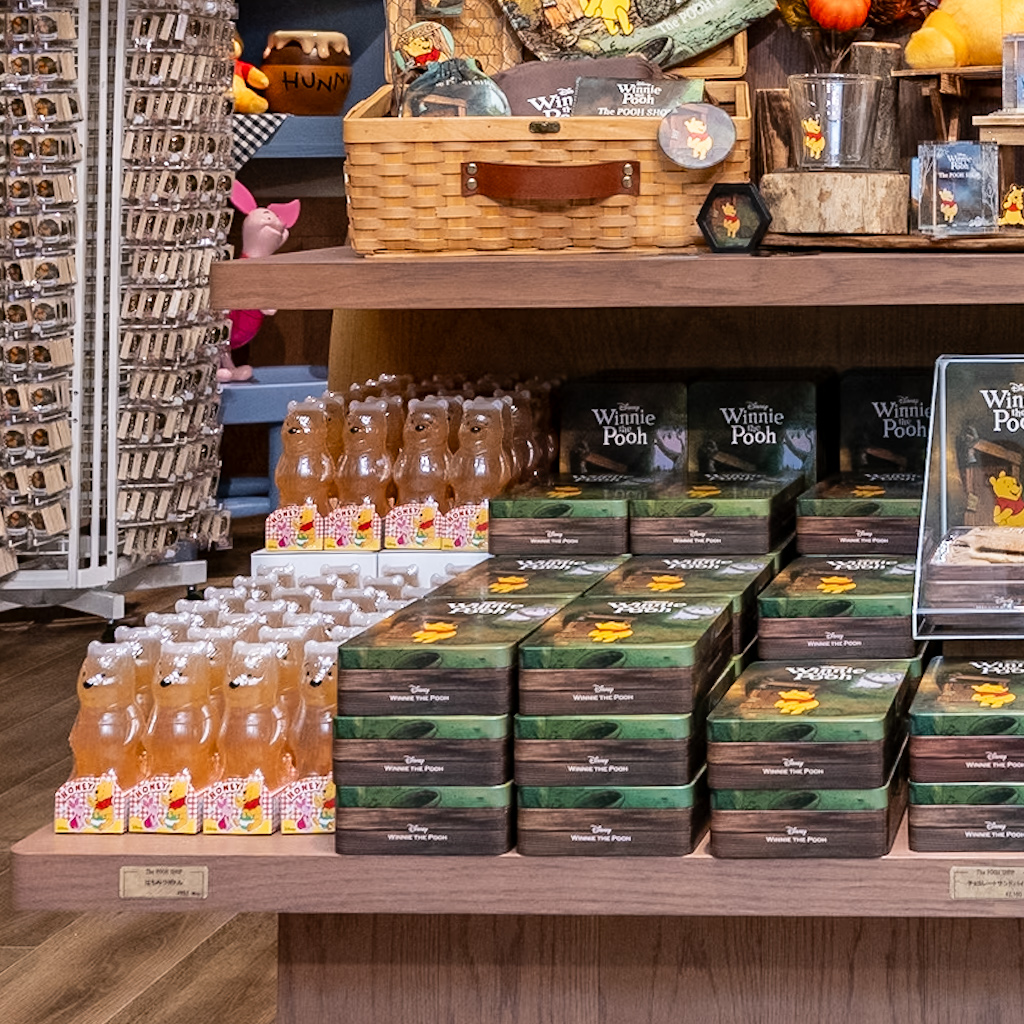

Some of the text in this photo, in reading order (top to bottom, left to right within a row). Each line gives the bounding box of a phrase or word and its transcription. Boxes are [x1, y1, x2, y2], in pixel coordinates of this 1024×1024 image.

[656, 19, 679, 33] The
[617, 82, 662, 96] Winnie
[528, 94, 573, 112] Win
[622, 93, 654, 105] Pooh
[598, 107, 615, 117] The
[616, 108, 647, 117] POOH
[591, 408, 656, 426] Winnie
[720, 407, 785, 425] Winnie
[731, 425, 777, 445] Pooh
[883, 417, 927, 438] Pooh
[603, 426, 648, 446] Pooh
[389, 694, 414, 702] WINNIE
[429, 694, 449, 702] POOH
[567, 765, 592, 773] WINNIE
[608, 765, 628, 773] POOH
[965, 761, 990, 769] WINNIE
[61, 782, 95, 799] HONEY
[135, 782, 167, 799] HONEY
[209, 783, 241, 799] HONEY
[286, 782, 320, 799] HONEY
[766, 836, 791, 844] WINNIE
[807, 836, 827, 844] POOH
